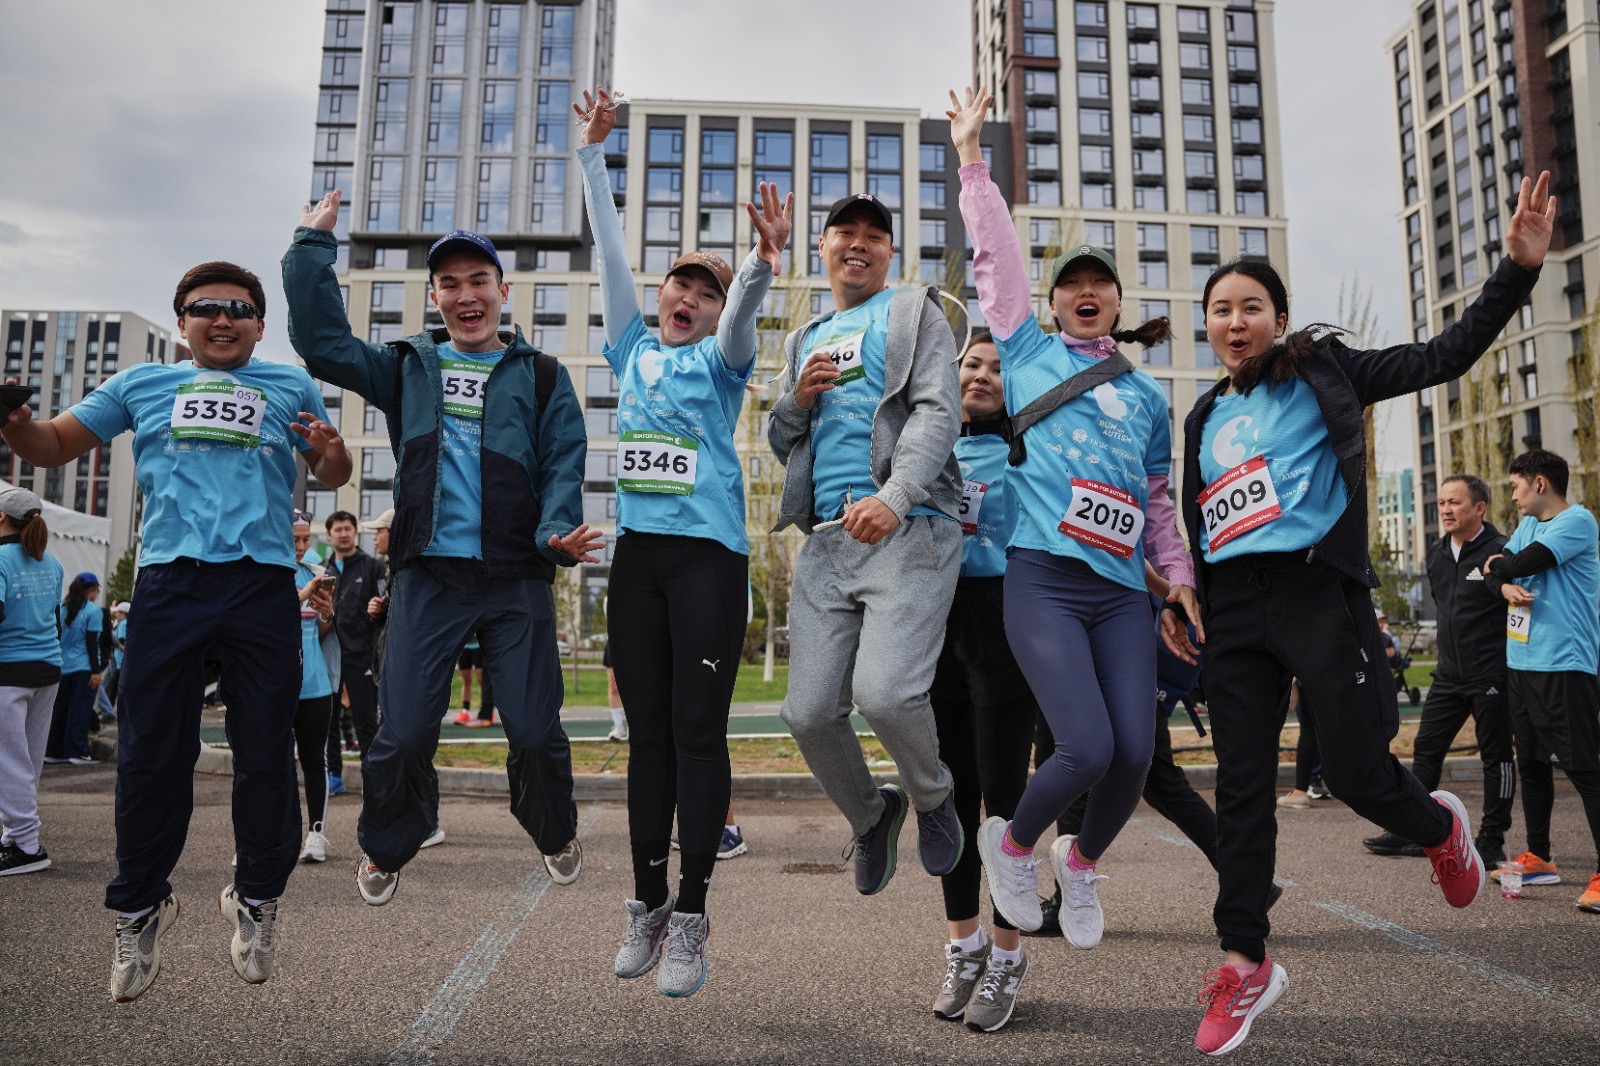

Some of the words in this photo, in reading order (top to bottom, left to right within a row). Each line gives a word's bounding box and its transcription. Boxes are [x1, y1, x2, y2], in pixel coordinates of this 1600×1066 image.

[237, 390, 259, 402] 057
[182, 400, 256, 427] 5352
[455, 418, 472, 427] RUN
[1098, 419, 1117, 431] RUN
[1102, 429, 1133, 444] AUTISM
[623, 449, 689, 475] 5346
[964, 483, 978, 493] 19
[1087, 481, 1099, 489] RUN
[959, 496, 971, 515] 5
[1206, 480, 1267, 532] 2009
[1075, 496, 1135, 535] 2019
[959, 961, 980, 981] N
[1003, 976, 1020, 996] N
